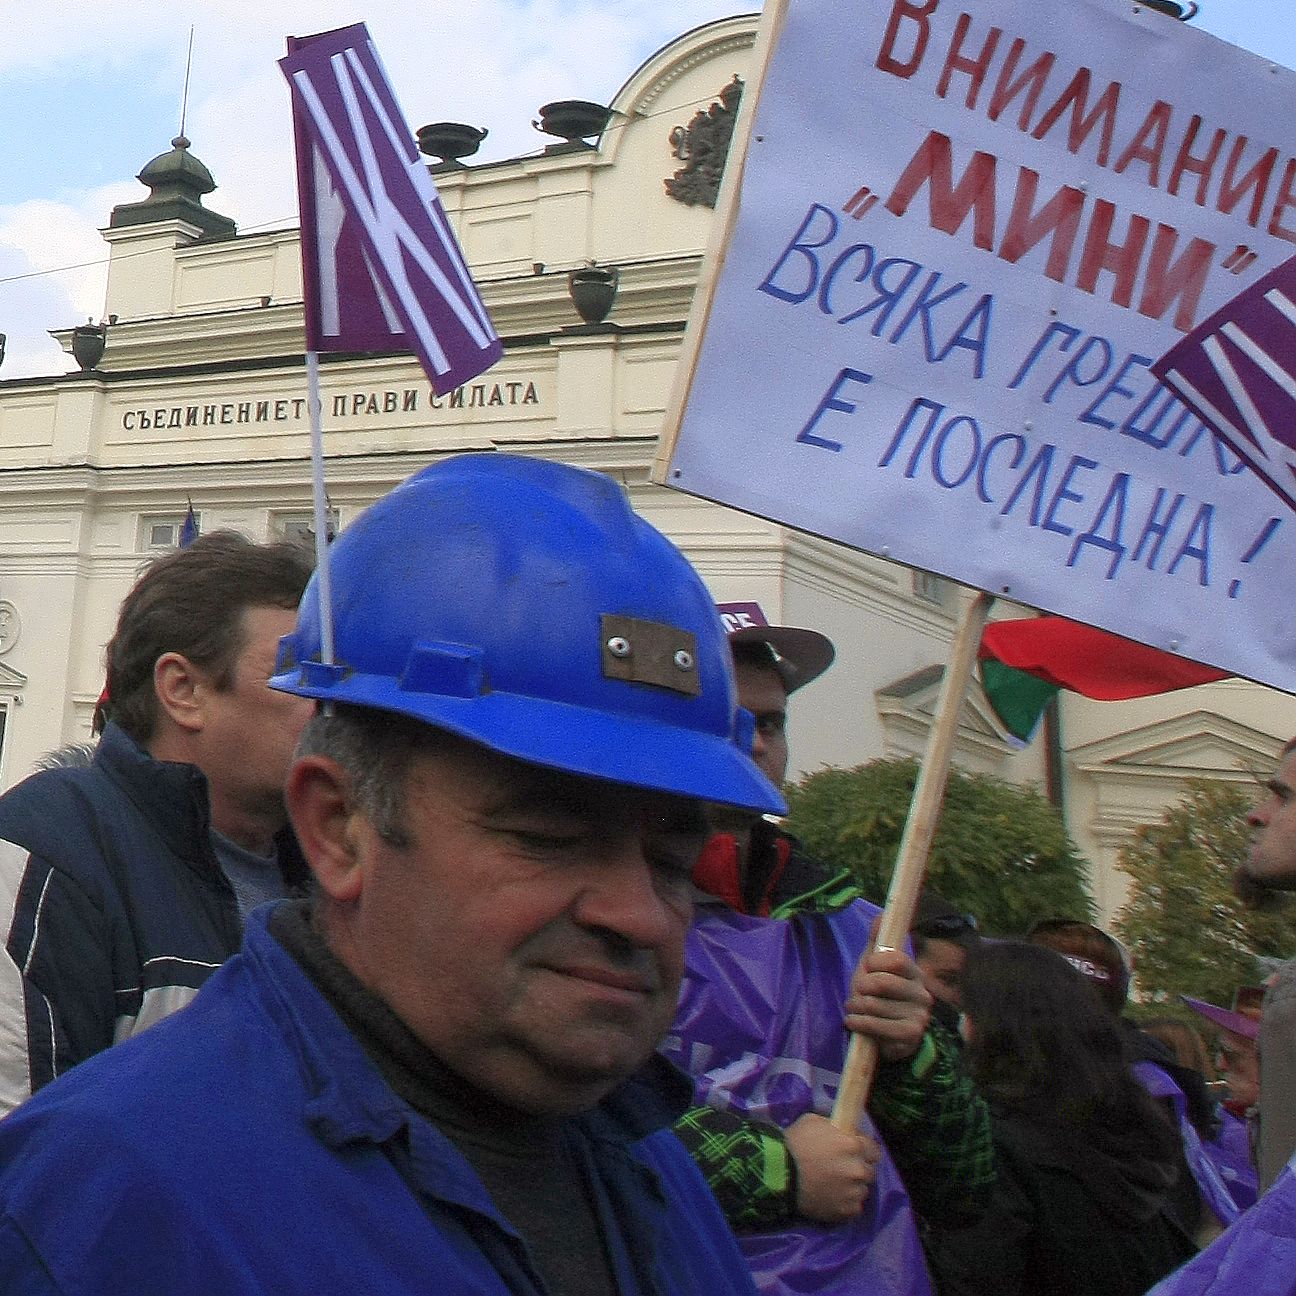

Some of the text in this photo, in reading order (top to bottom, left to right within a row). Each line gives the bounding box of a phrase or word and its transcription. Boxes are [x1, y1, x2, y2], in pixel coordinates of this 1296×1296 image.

[757, 203, 996, 380] ВСЯКА
[332, 389, 419, 416] ПРАВИ
[796, 367, 873, 453] Е
